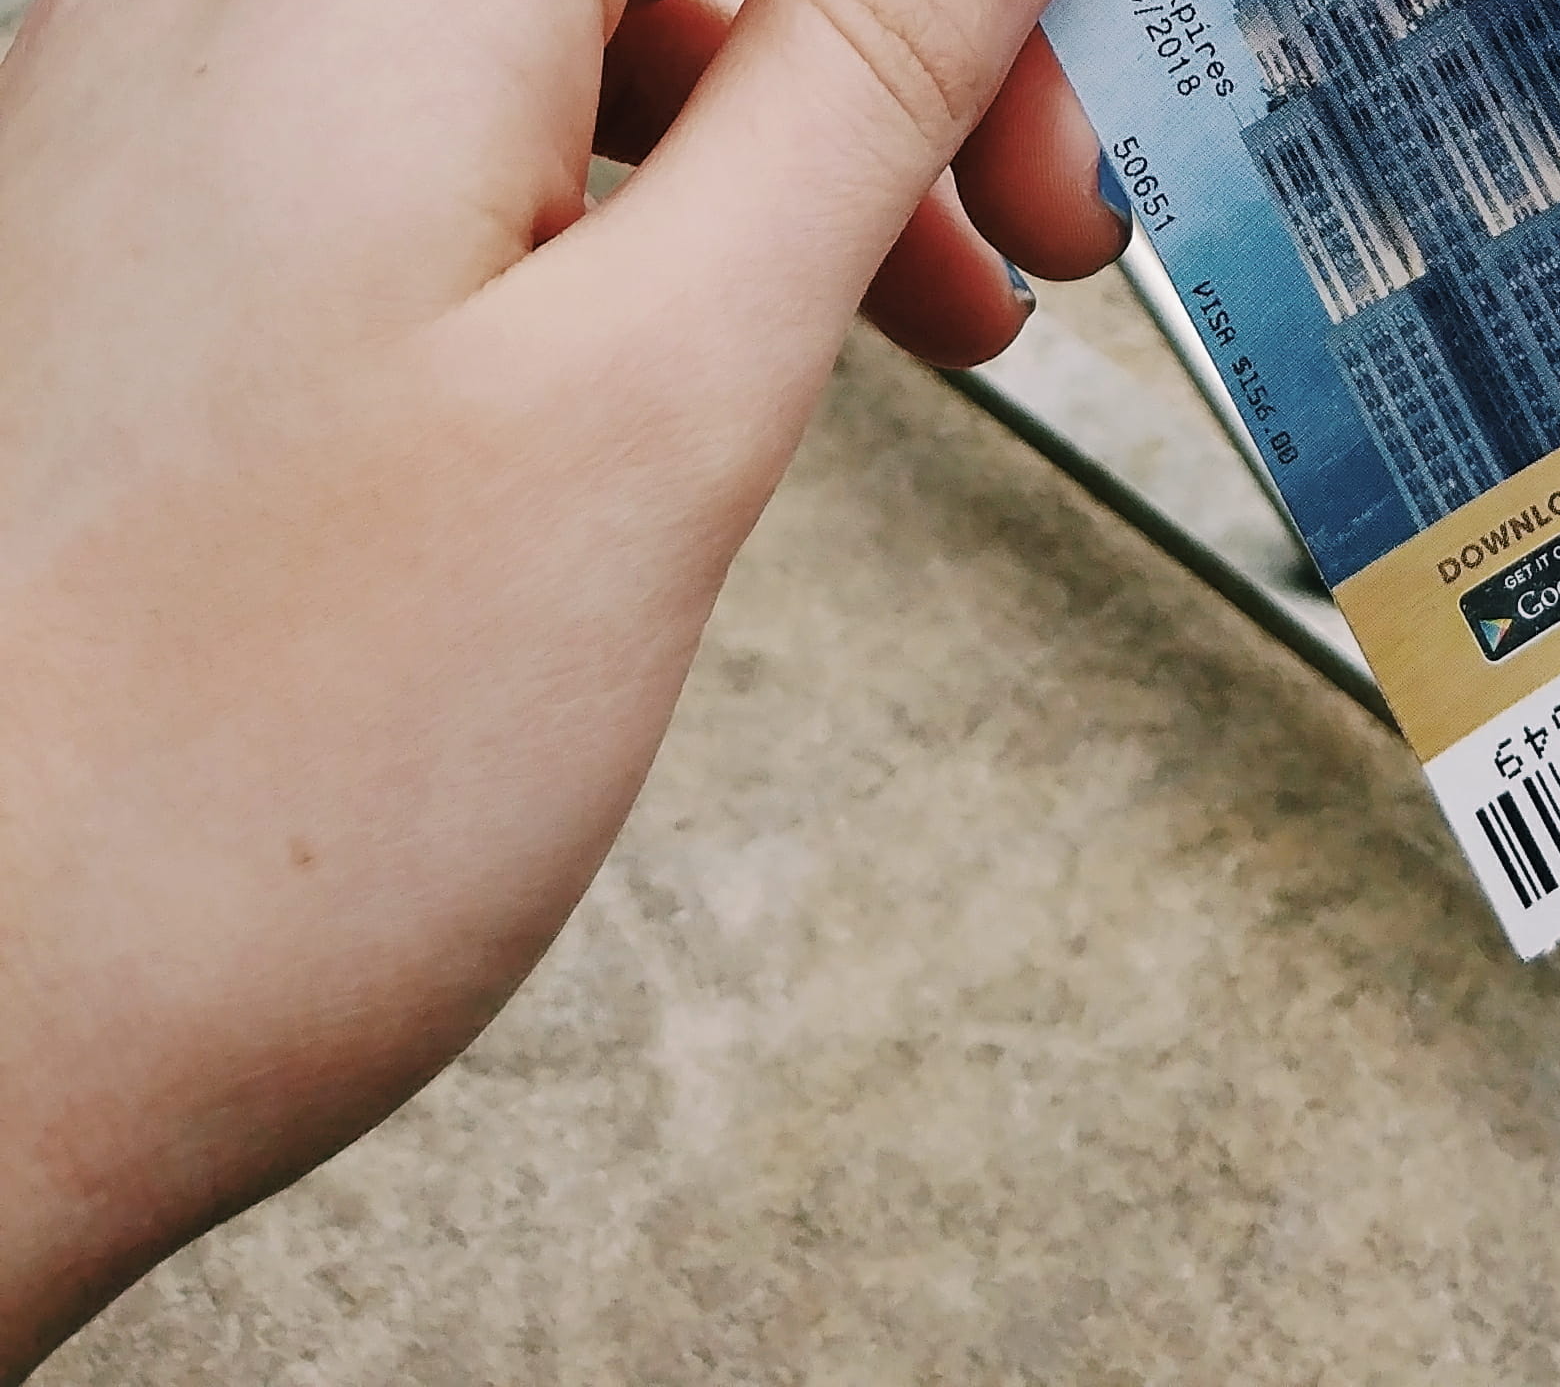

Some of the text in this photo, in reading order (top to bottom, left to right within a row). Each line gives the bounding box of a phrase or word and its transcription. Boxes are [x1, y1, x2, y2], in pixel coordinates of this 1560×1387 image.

[1113, 136, 1177, 232] 50651
[1192, 281, 1299, 466] VISA $156.00
[1504, 560, 1534, 590] GET
[1534, 553, 1551, 575] IT
